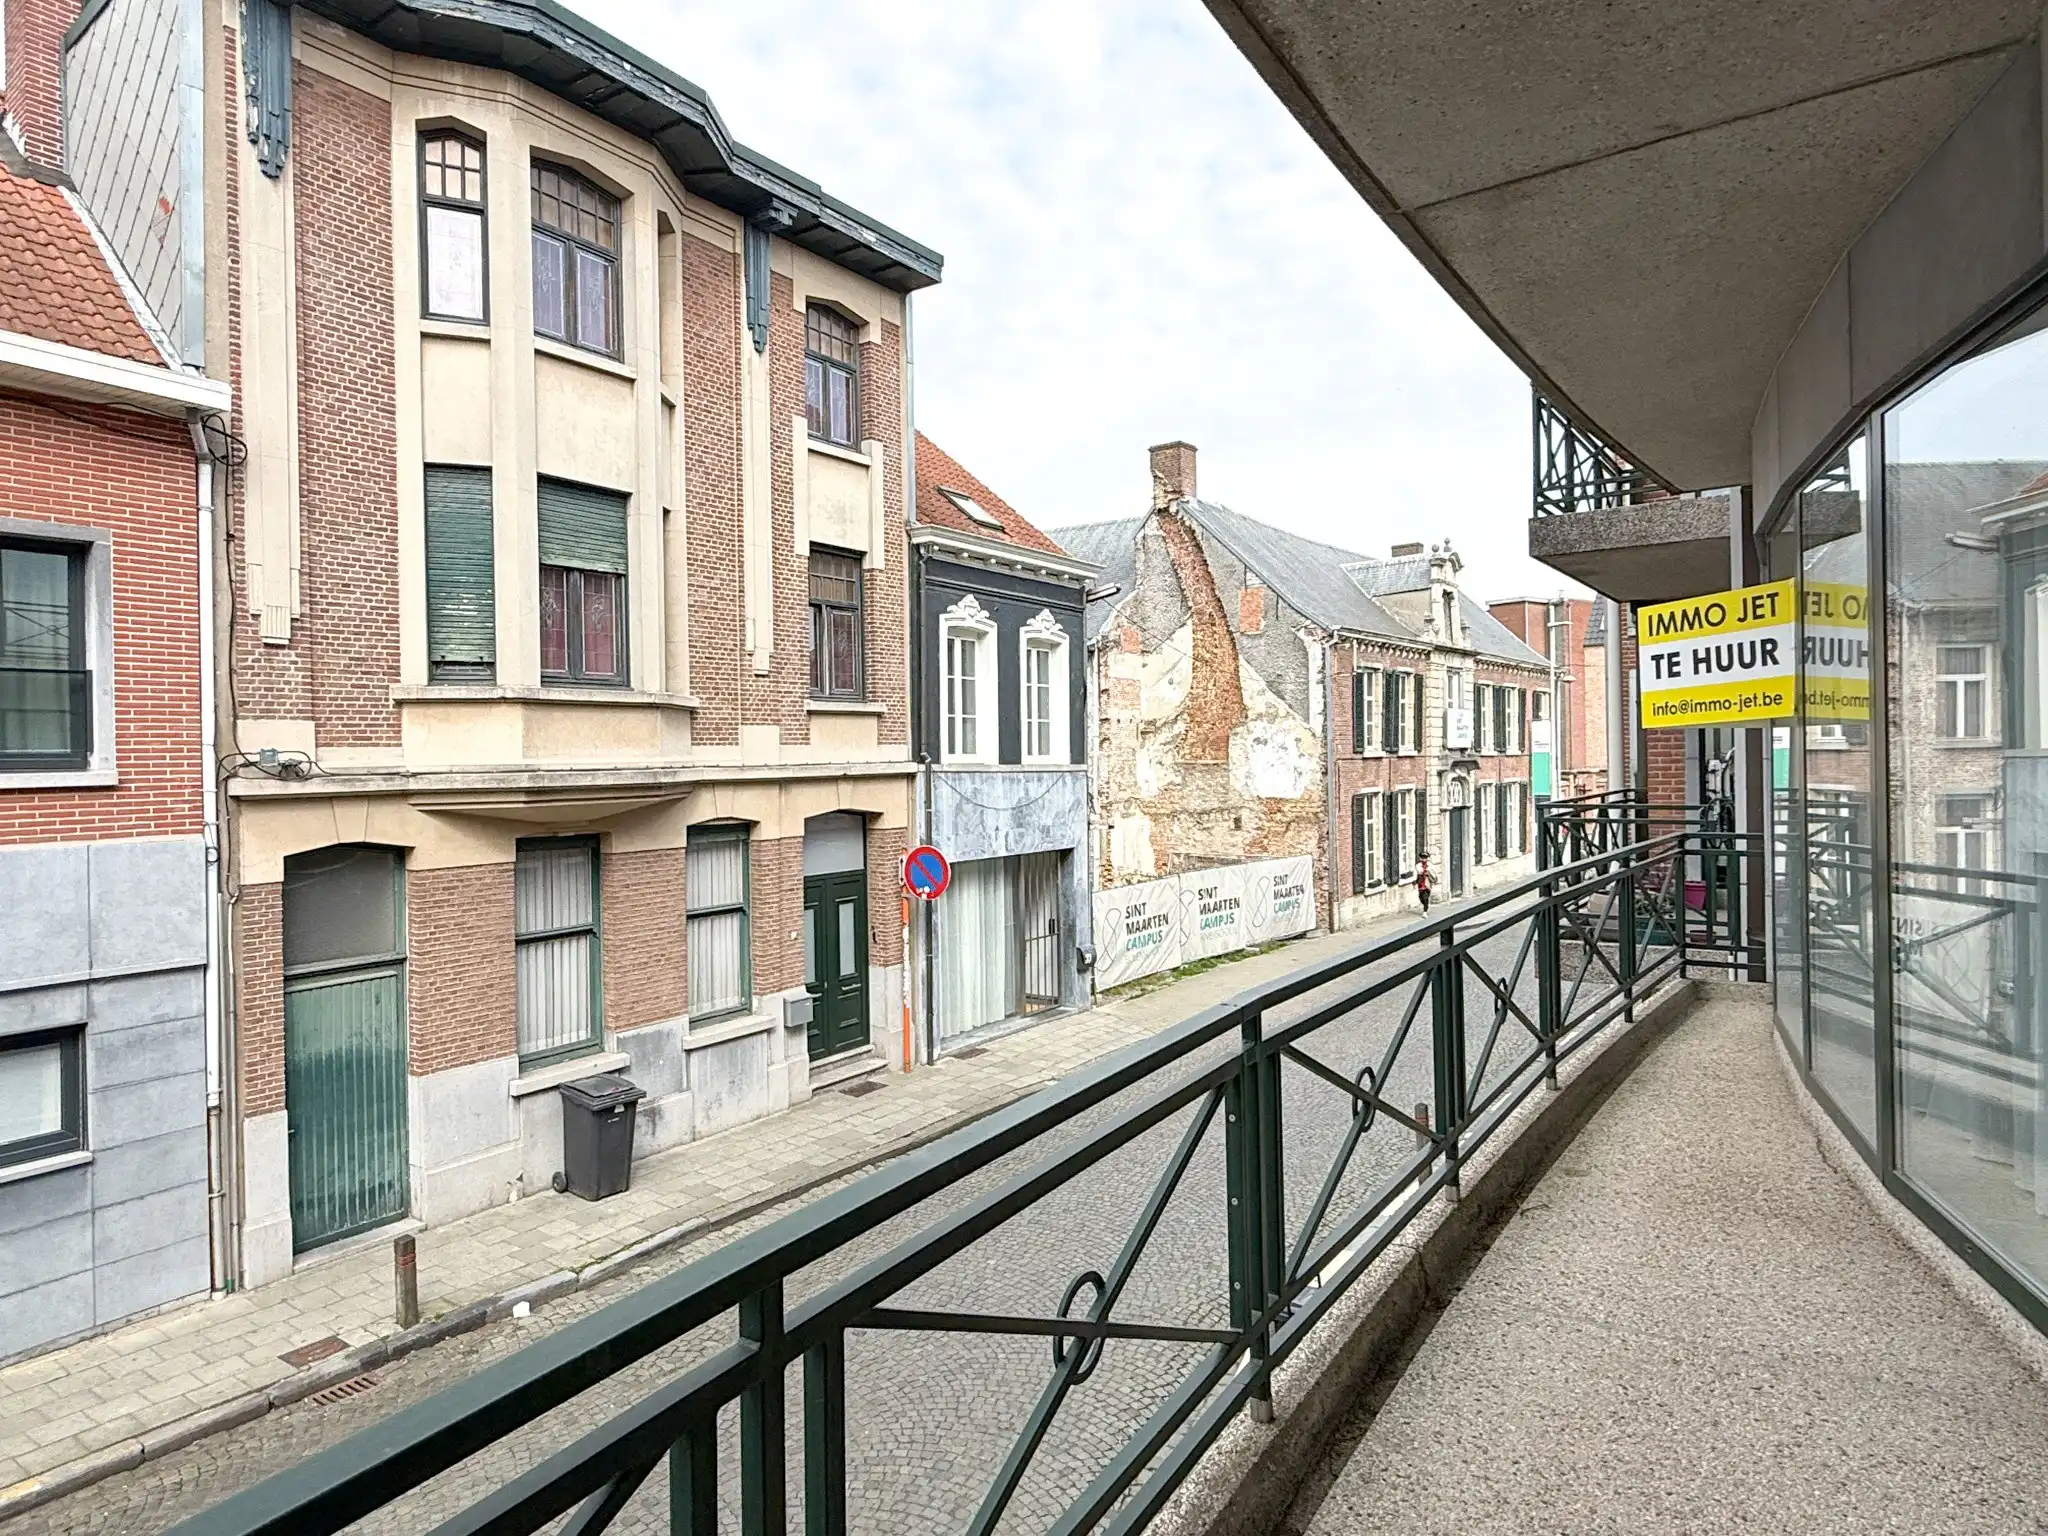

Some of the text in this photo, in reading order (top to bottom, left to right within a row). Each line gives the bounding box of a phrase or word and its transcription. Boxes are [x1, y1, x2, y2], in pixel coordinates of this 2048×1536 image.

[1648, 592, 1779, 637] IMMO JET
[1651, 638, 1780, 680] TE HUUR
[1653, 692, 1783, 716] info@immo-jet.be
[1273, 874, 1288, 886] SINT
[1198, 886, 1218, 900] SINT
[1125, 902, 1147, 919] SINT
[1199, 897, 1240, 915] MAARTEN
[1126, 912, 1168, 935] MAARTEN
[1199, 912, 1235, 930] CAMPUS
[1126, 930, 1163, 951] CAMPUS
